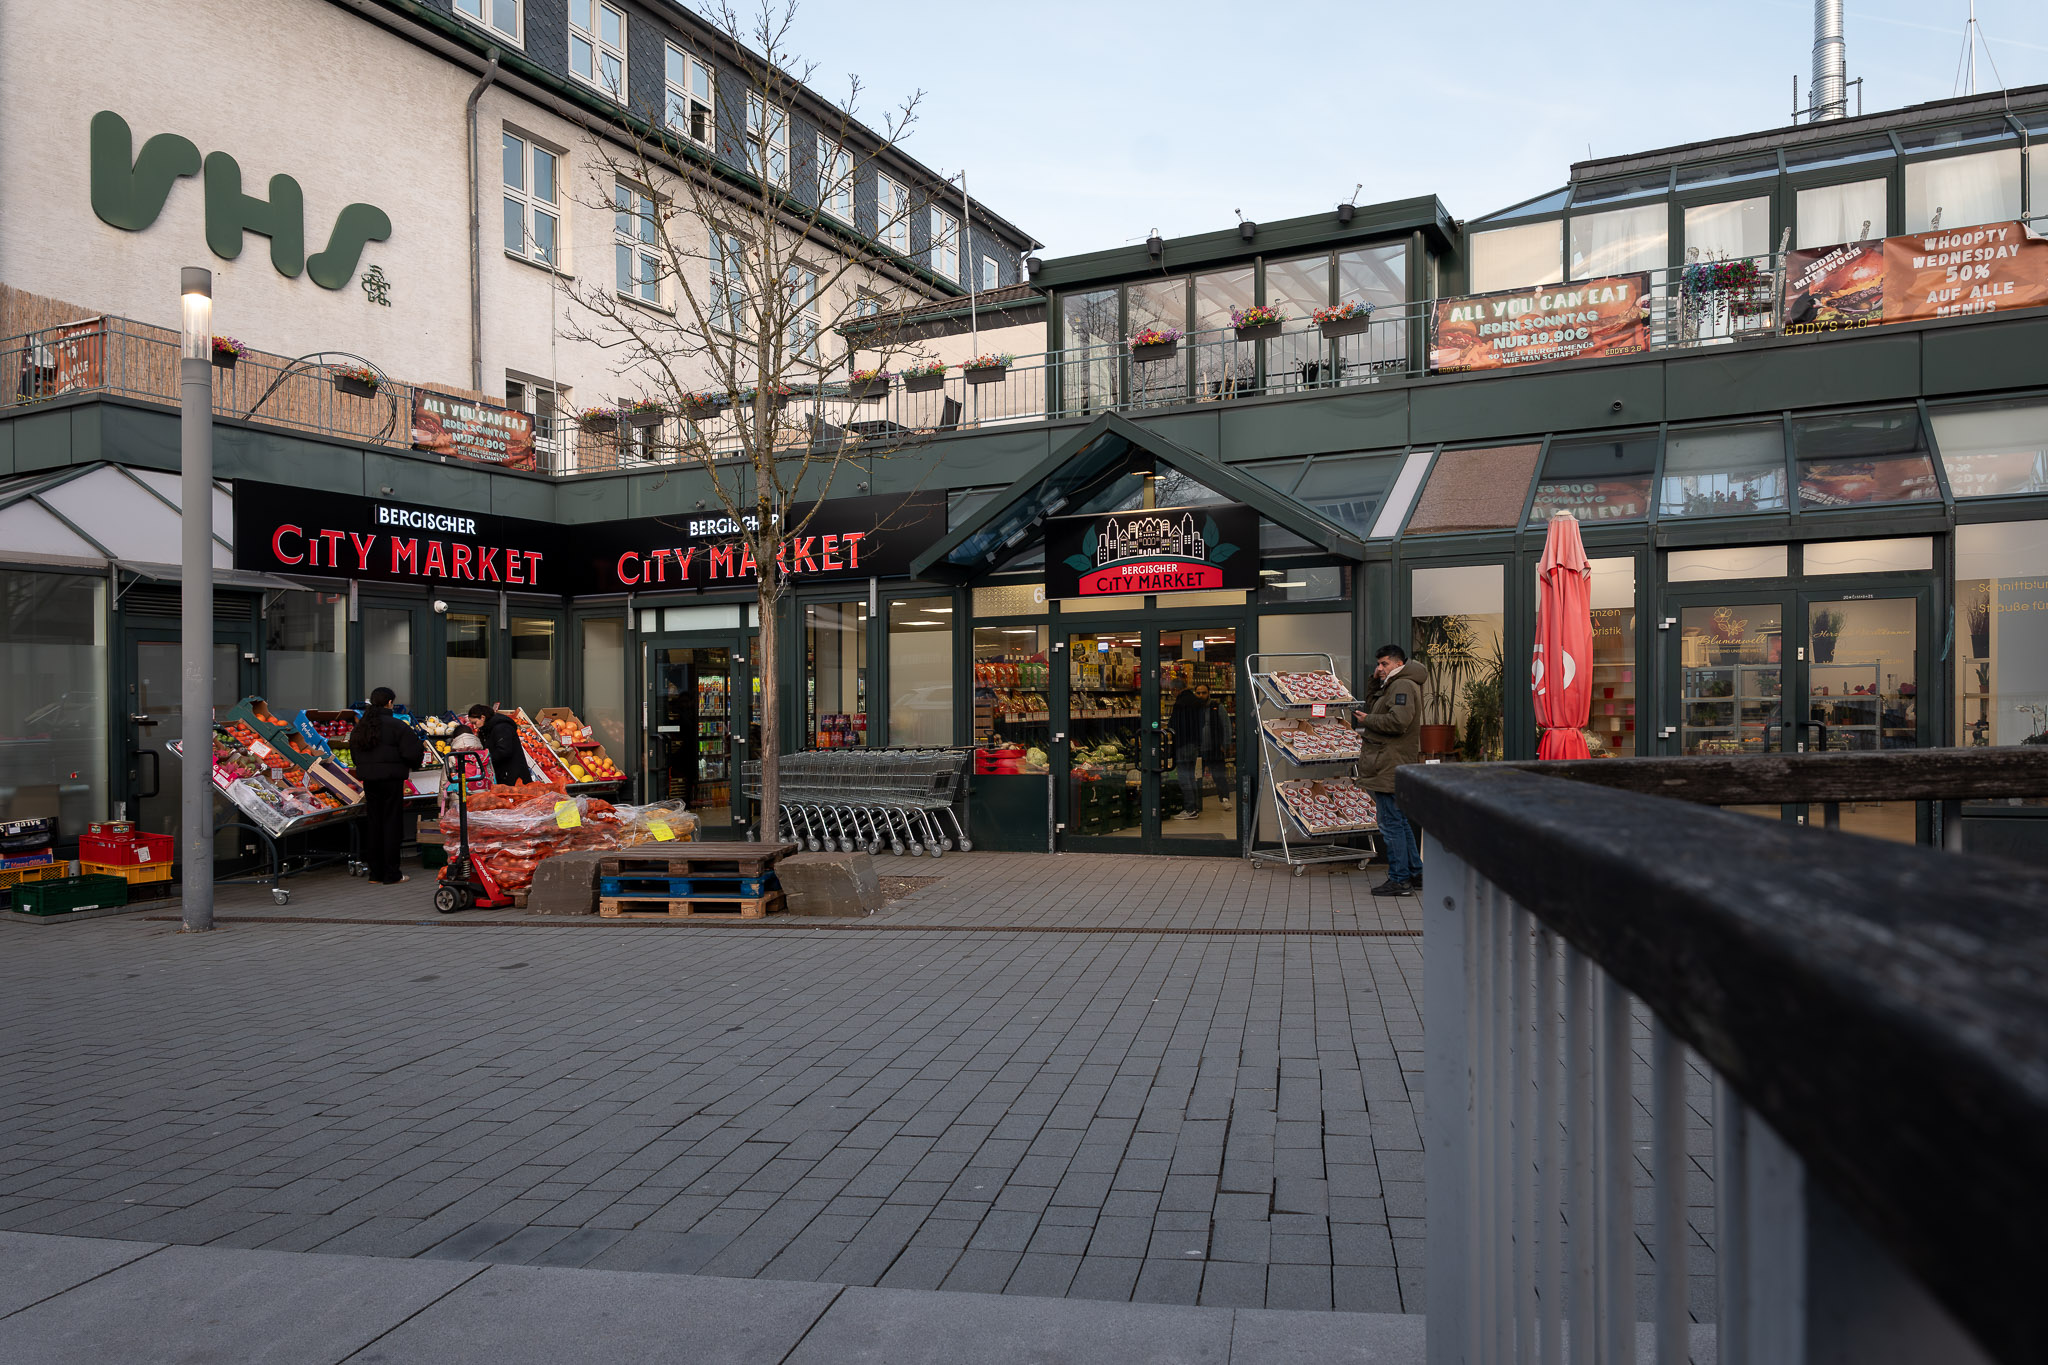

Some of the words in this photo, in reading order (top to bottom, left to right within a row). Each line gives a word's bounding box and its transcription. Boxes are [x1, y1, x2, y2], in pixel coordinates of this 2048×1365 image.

[1924, 227, 2009, 251] WHOOPTY
[1803, 248, 1843, 275] JEDEN
[1912, 244, 2020, 269] WEDNESDAY
[1793, 247, 1862, 290] MITTWOCH
[1945, 263, 1991, 284] 50%
[1926, 288, 1961, 304] AUF
[1969, 281, 2015, 298] ALLE
[1450, 305, 1486, 323] ALL
[1492, 297, 1534, 317] YOU
[1540, 292, 1583, 311] CAN
[1588, 285, 1629, 304] EAT
[1936, 298, 1997, 318] MENÜS
[1479, 320, 1521, 337] JEDEN
[1523, 310, 1599, 331] SONNTAG
[1785, 321, 1838, 337] EDDY'S
[1844, 318, 1868, 331] 2.0
[1493, 334, 1528, 350] NUR
[1488, 353, 1500, 361] SO
[1502, 349, 1526, 359] VIELE
[1521, 354, 1540, 362] MAN
[1541, 349, 1581, 361] SCHAFFT
[424, 398, 446, 414] ALL
[451, 403, 475, 420] YOU
[478, 410, 502, 426] CAN
[504, 416, 528, 431] EAT
[442, 418, 468, 430] JEDEN
[469, 424, 511, 440] SONNTAG
[452, 432, 473, 445] NUR
[379, 506, 477, 535] BERGISCHER
[390, 535, 543, 585] MARKET
[1122, 564, 1178, 575] BERGISCHER
[1138, 571, 1206, 590] MARKET
